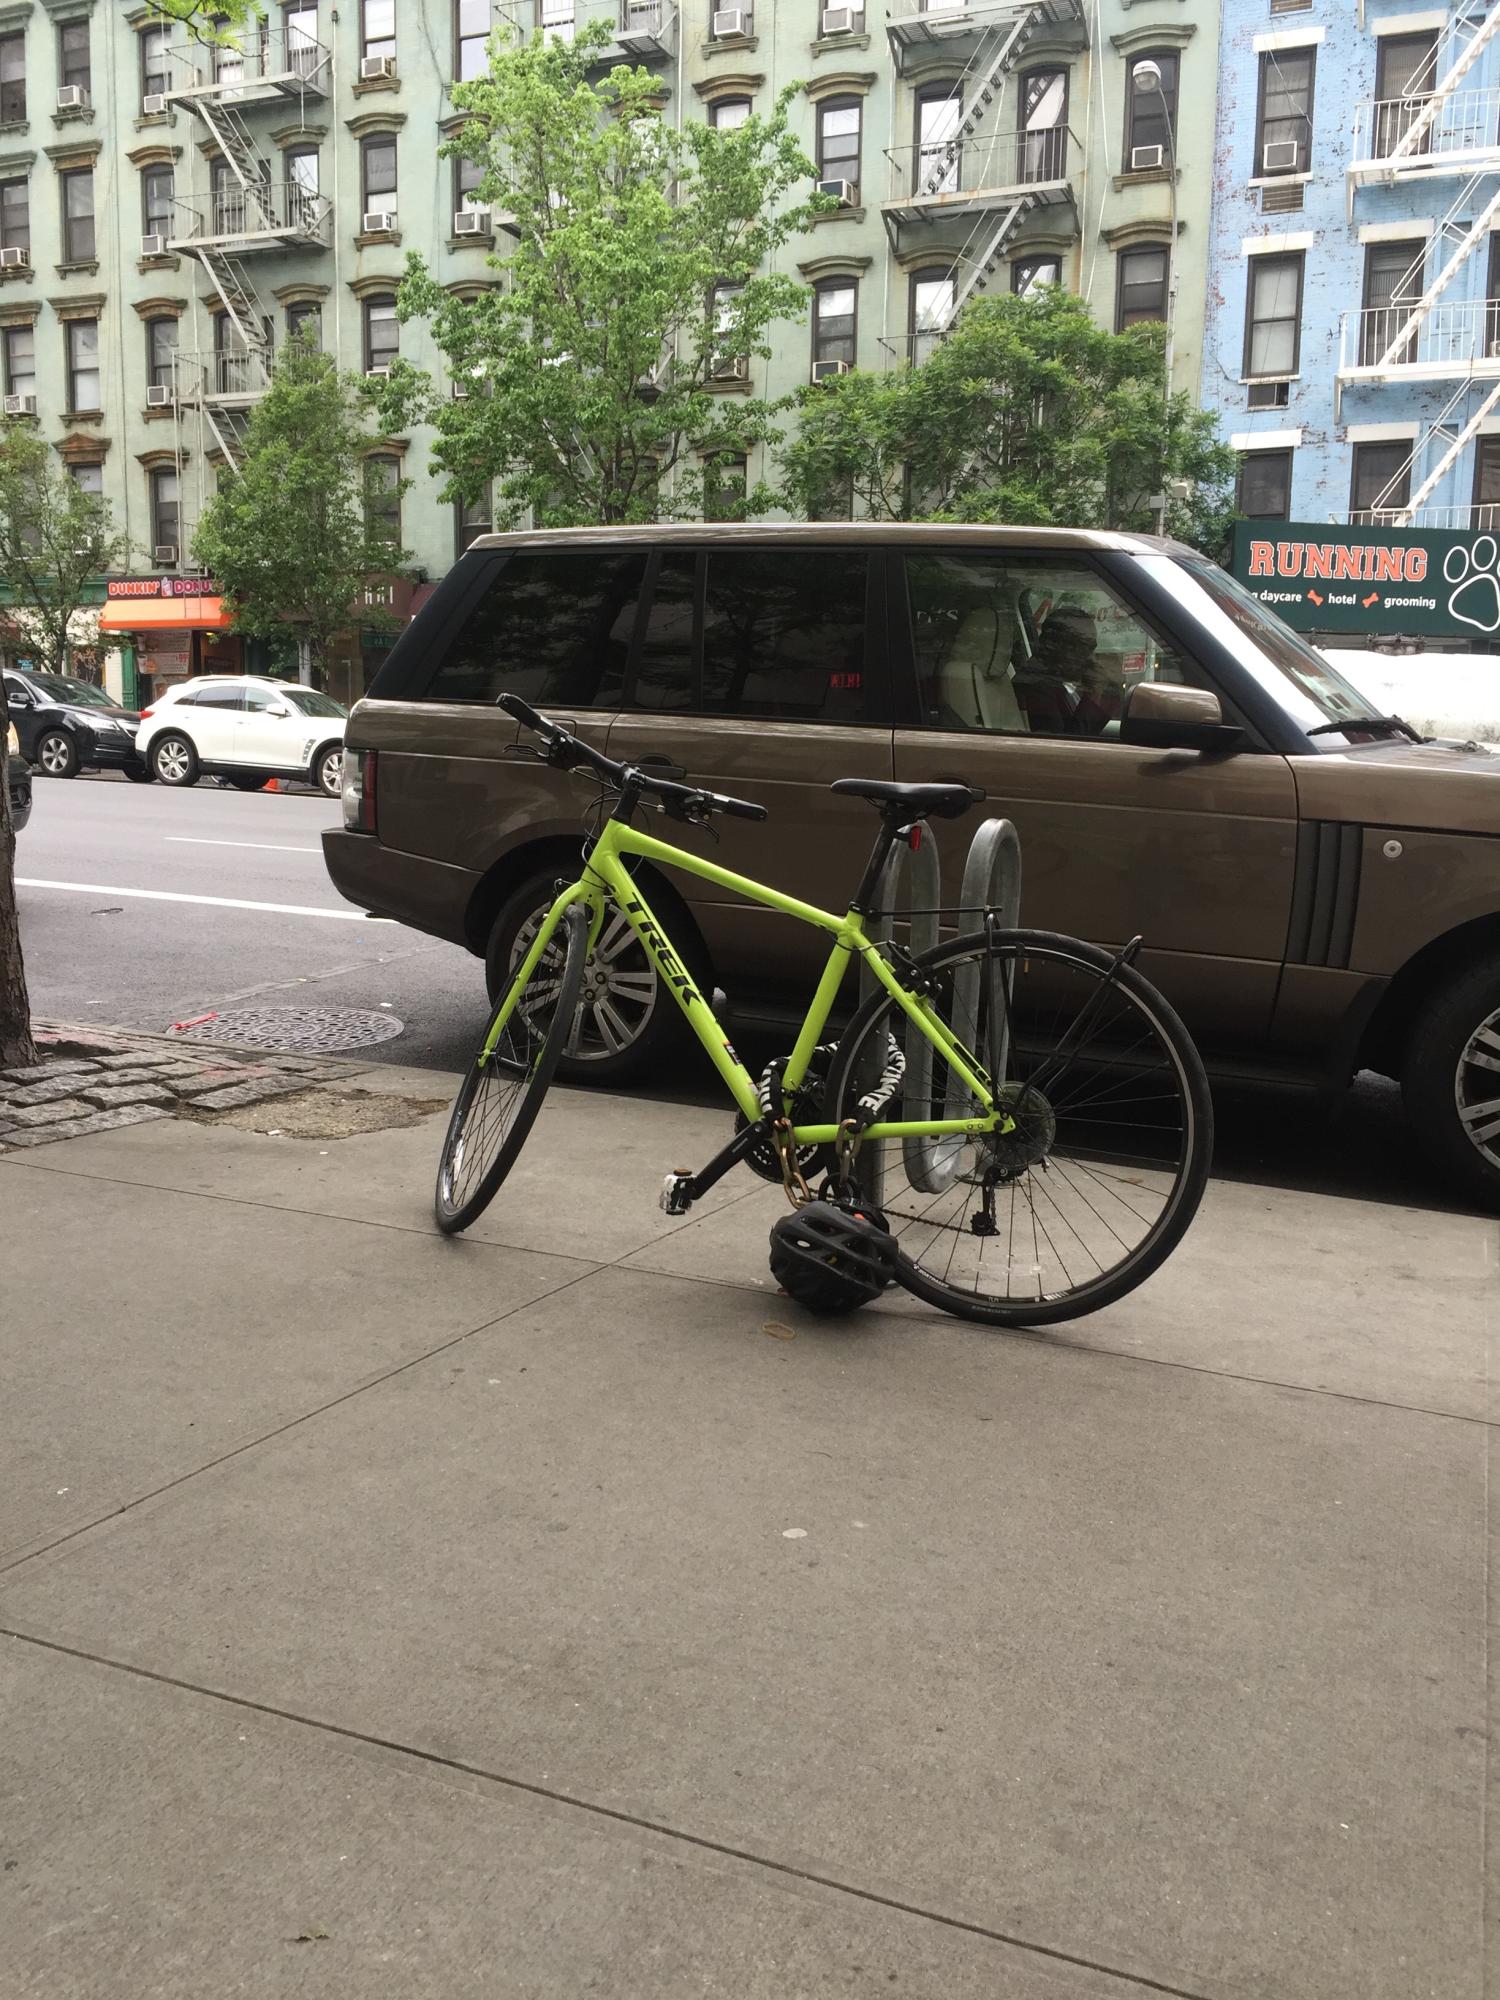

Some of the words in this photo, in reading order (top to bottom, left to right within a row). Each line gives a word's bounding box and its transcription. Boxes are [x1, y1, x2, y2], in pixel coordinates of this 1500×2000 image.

[1249, 541, 1428, 582] RUNNING
[108, 581, 160, 596] DUNKIN'
[174, 580, 224, 593] DONUS
[1259, 590, 1302, 603] daycare
[1328, 593, 1356, 605] hotel
[1384, 597, 1436, 610] grooming
[626, 892, 701, 1007] TREK
